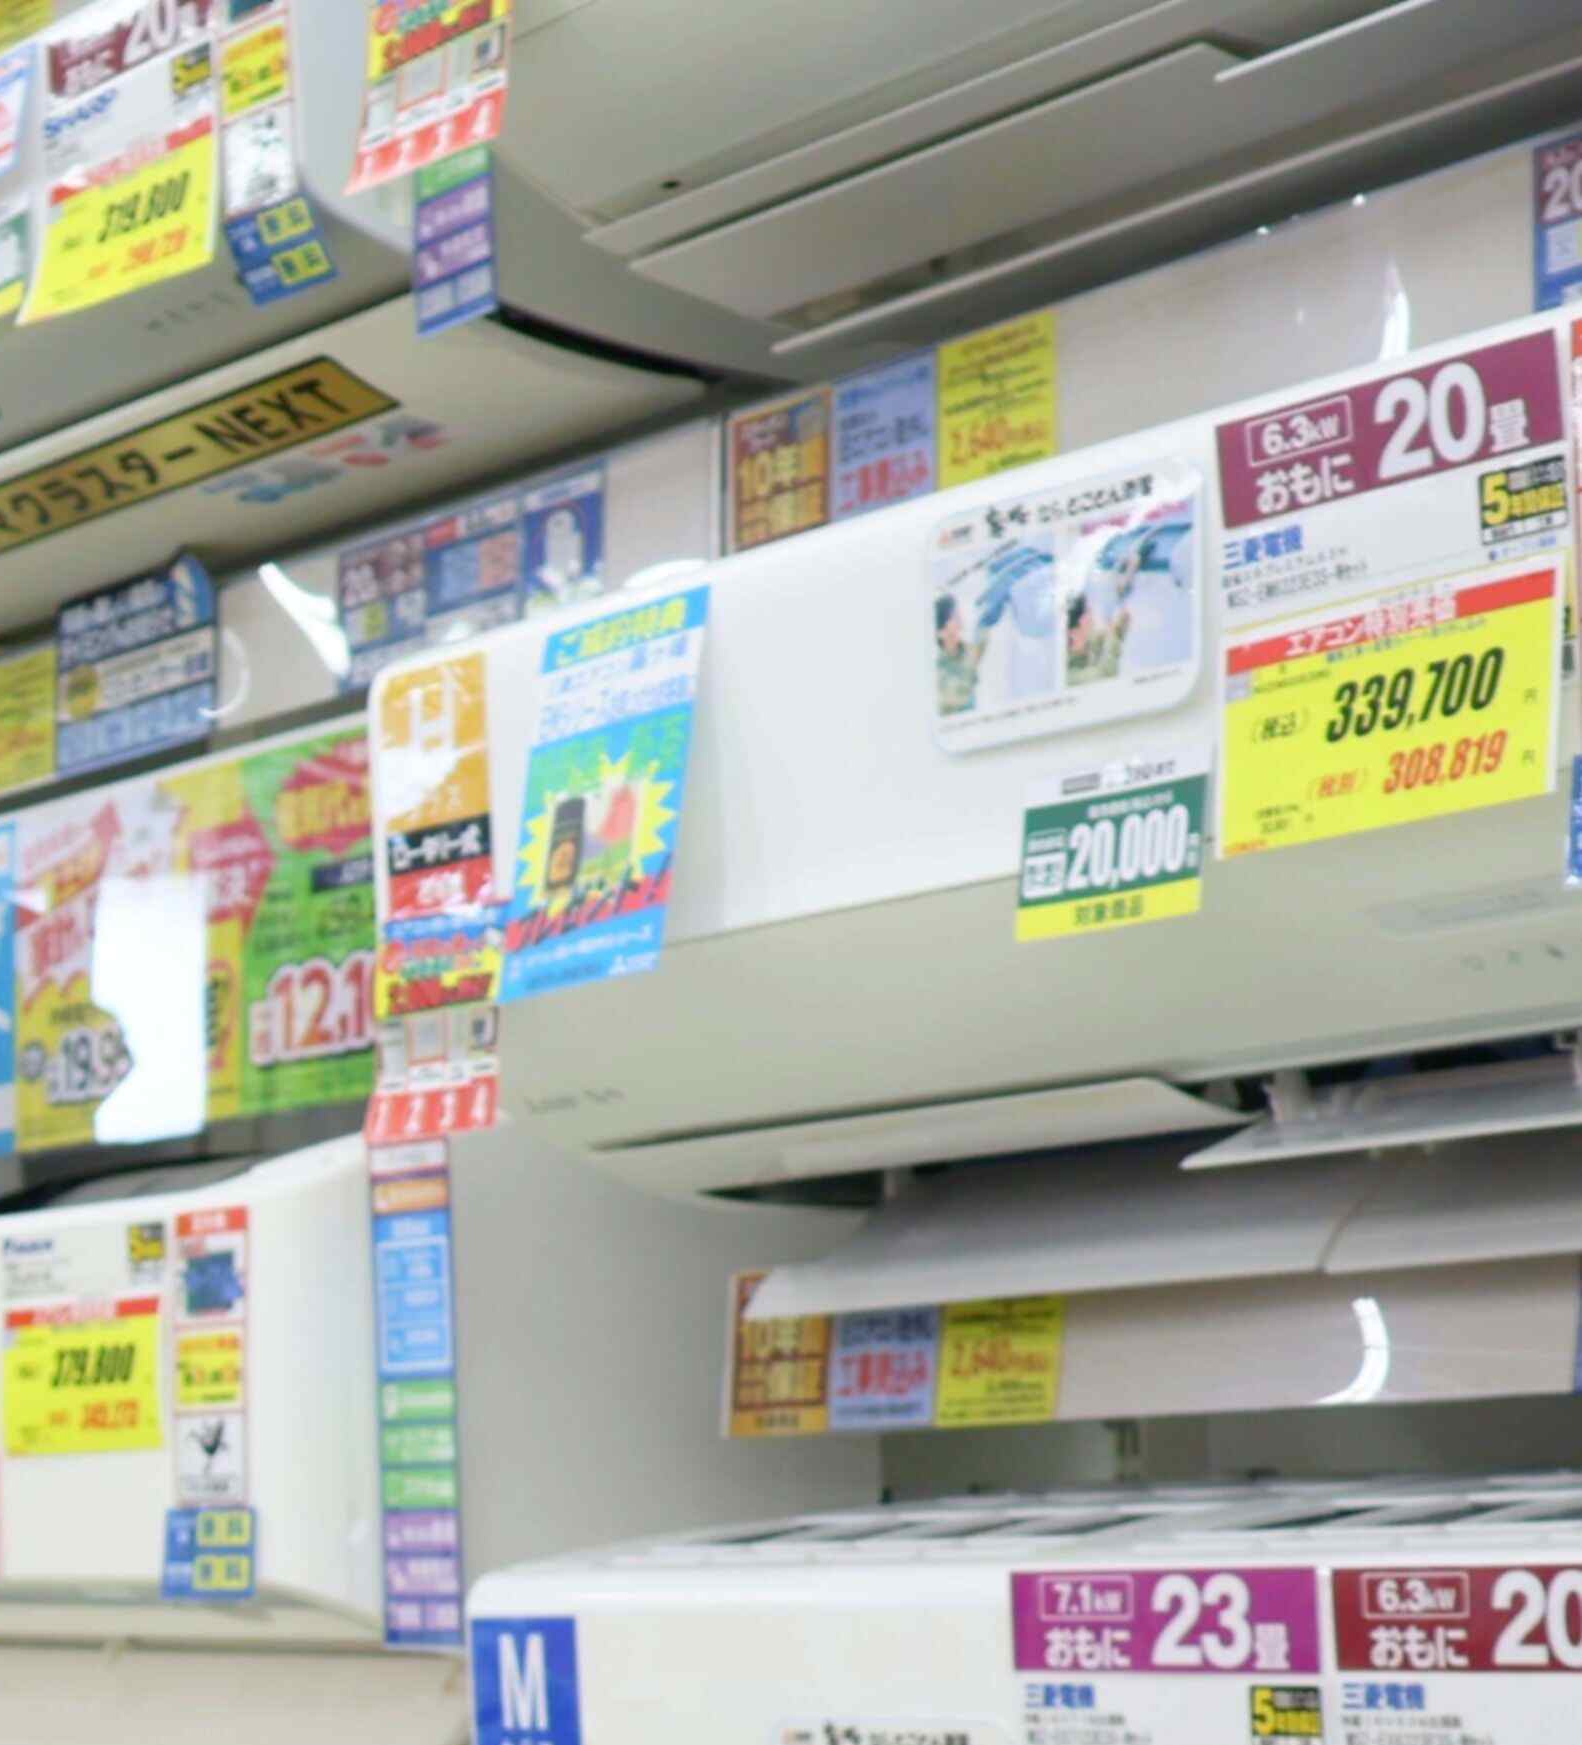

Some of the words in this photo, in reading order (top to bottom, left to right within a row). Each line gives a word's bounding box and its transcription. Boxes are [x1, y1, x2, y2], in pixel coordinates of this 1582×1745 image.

[1255, 457, 1355, 513] おもに
[1374, 362, 1528, 480] 20畳
[1260, 412, 1344, 456] 6.3kW
[1221, 524, 1304, 570] 三菱電機
[1325, 646, 1504, 745] 339,700
[1383, 731, 1509, 797] 308,819
[1066, 806, 1189, 891] 20,000
[272, 959, 373, 1052] 12,1
[1044, 1628, 1132, 1670] おもに
[1151, 1574, 1289, 1669] 23畳
[1053, 1580, 1123, 1617] 7.1kW
[1377, 1579, 1456, 1611] 6.3kW
[1370, 1625, 1468, 1667] おもに
[498, 1634, 548, 1731] M
[1024, 1683, 1094, 1710] 三菱電機
[1343, 1683, 1425, 1710] 三菱電機
